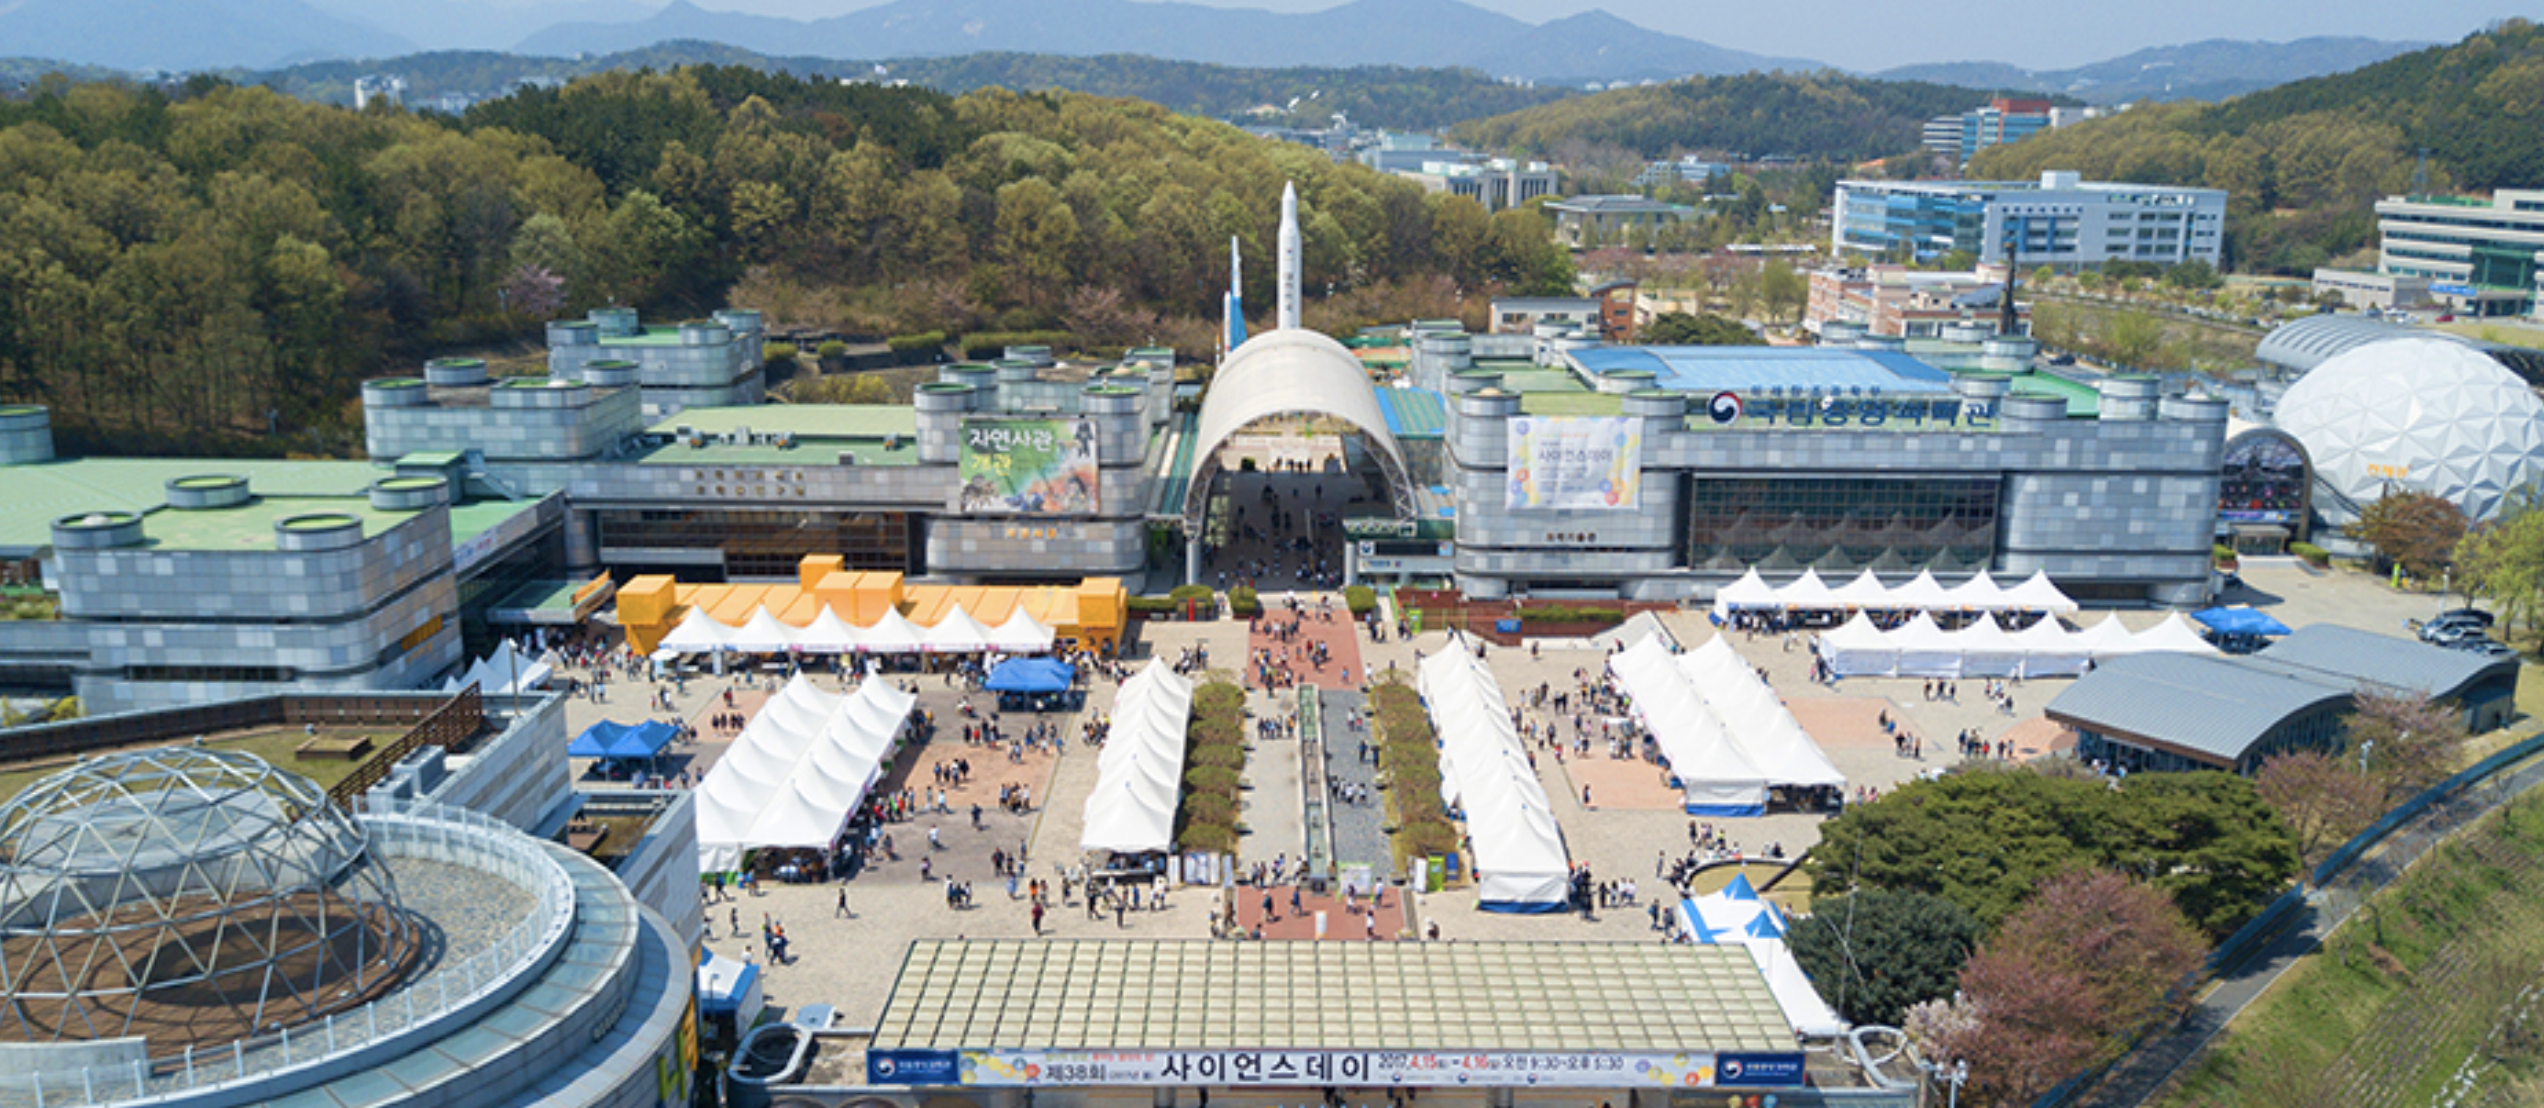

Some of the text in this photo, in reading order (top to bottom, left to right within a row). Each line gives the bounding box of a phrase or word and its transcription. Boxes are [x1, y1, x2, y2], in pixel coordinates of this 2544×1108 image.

[969, 428, 1053, 452] 자연사관
[971, 453, 1011, 476] 개관
[1160, 1053, 1369, 1082] 사이언스데이
